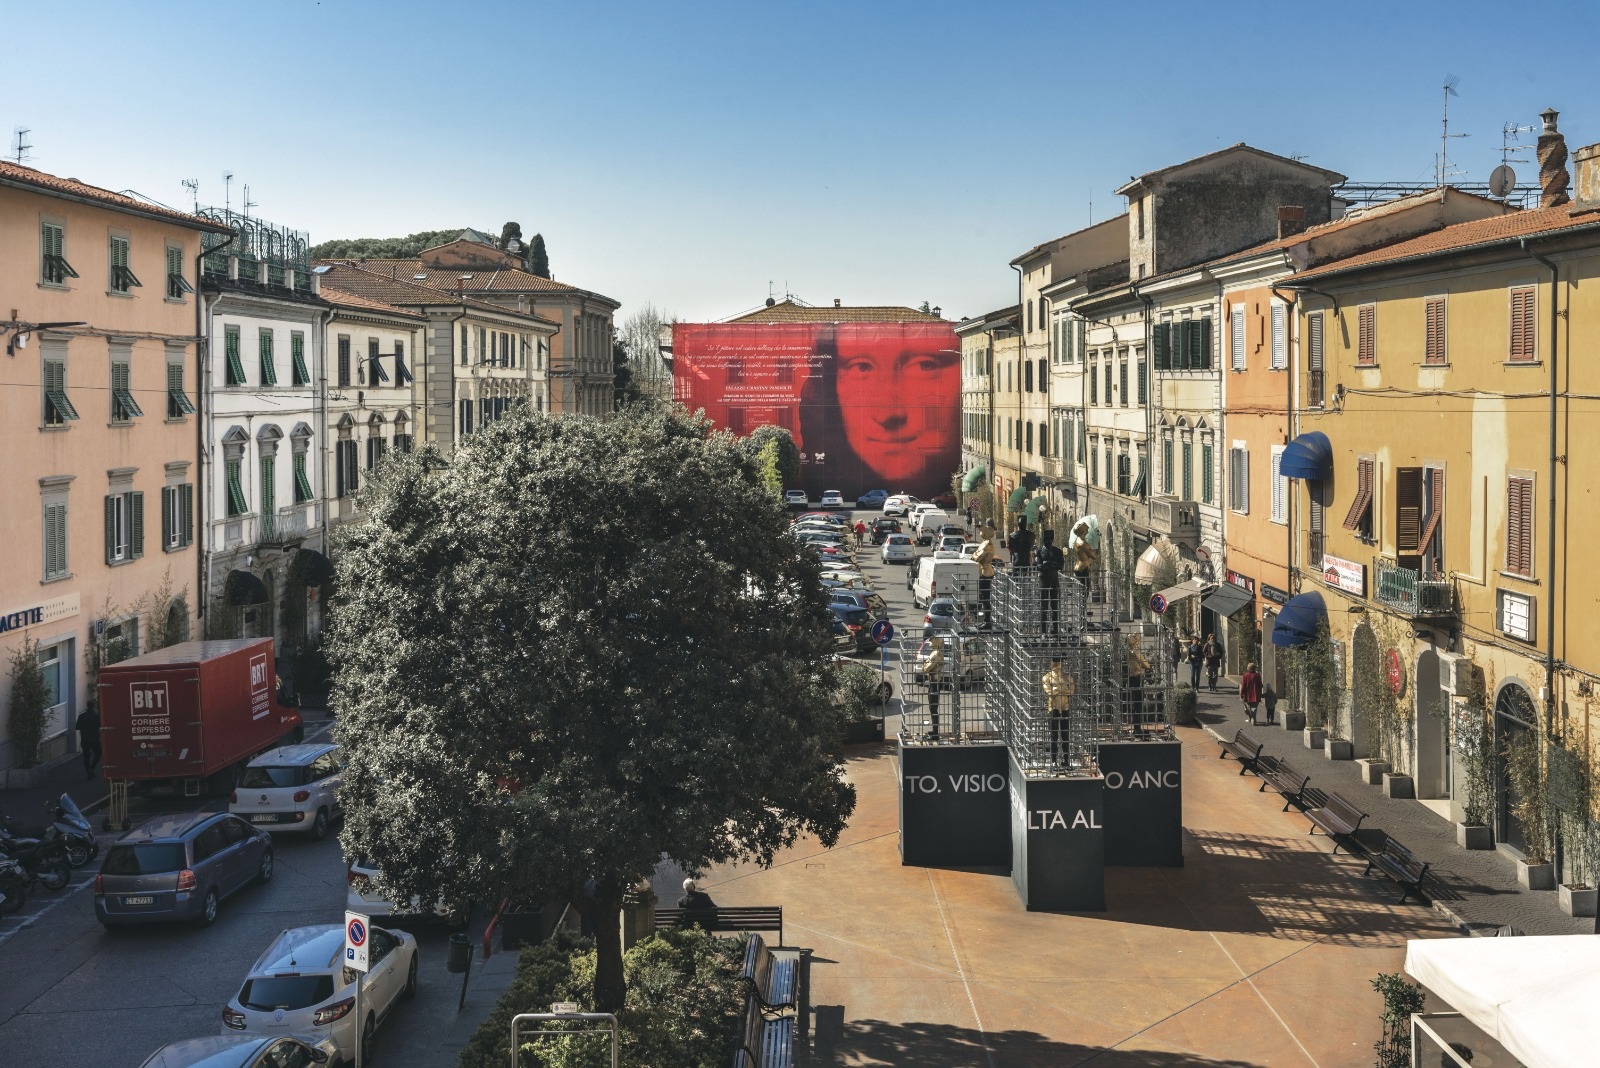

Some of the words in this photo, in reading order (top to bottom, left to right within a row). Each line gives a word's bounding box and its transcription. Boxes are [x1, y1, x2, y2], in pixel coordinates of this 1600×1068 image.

[252, 662, 266, 686] BRT
[134, 690, 164, 708] BRT
[906, 776, 942, 794] TO.
[949, 774, 1005, 793] VISIO
[1128, 770, 1178, 788] ANC
[1028, 810, 1067, 830] LTA
[1072, 810, 1102, 829] AL
